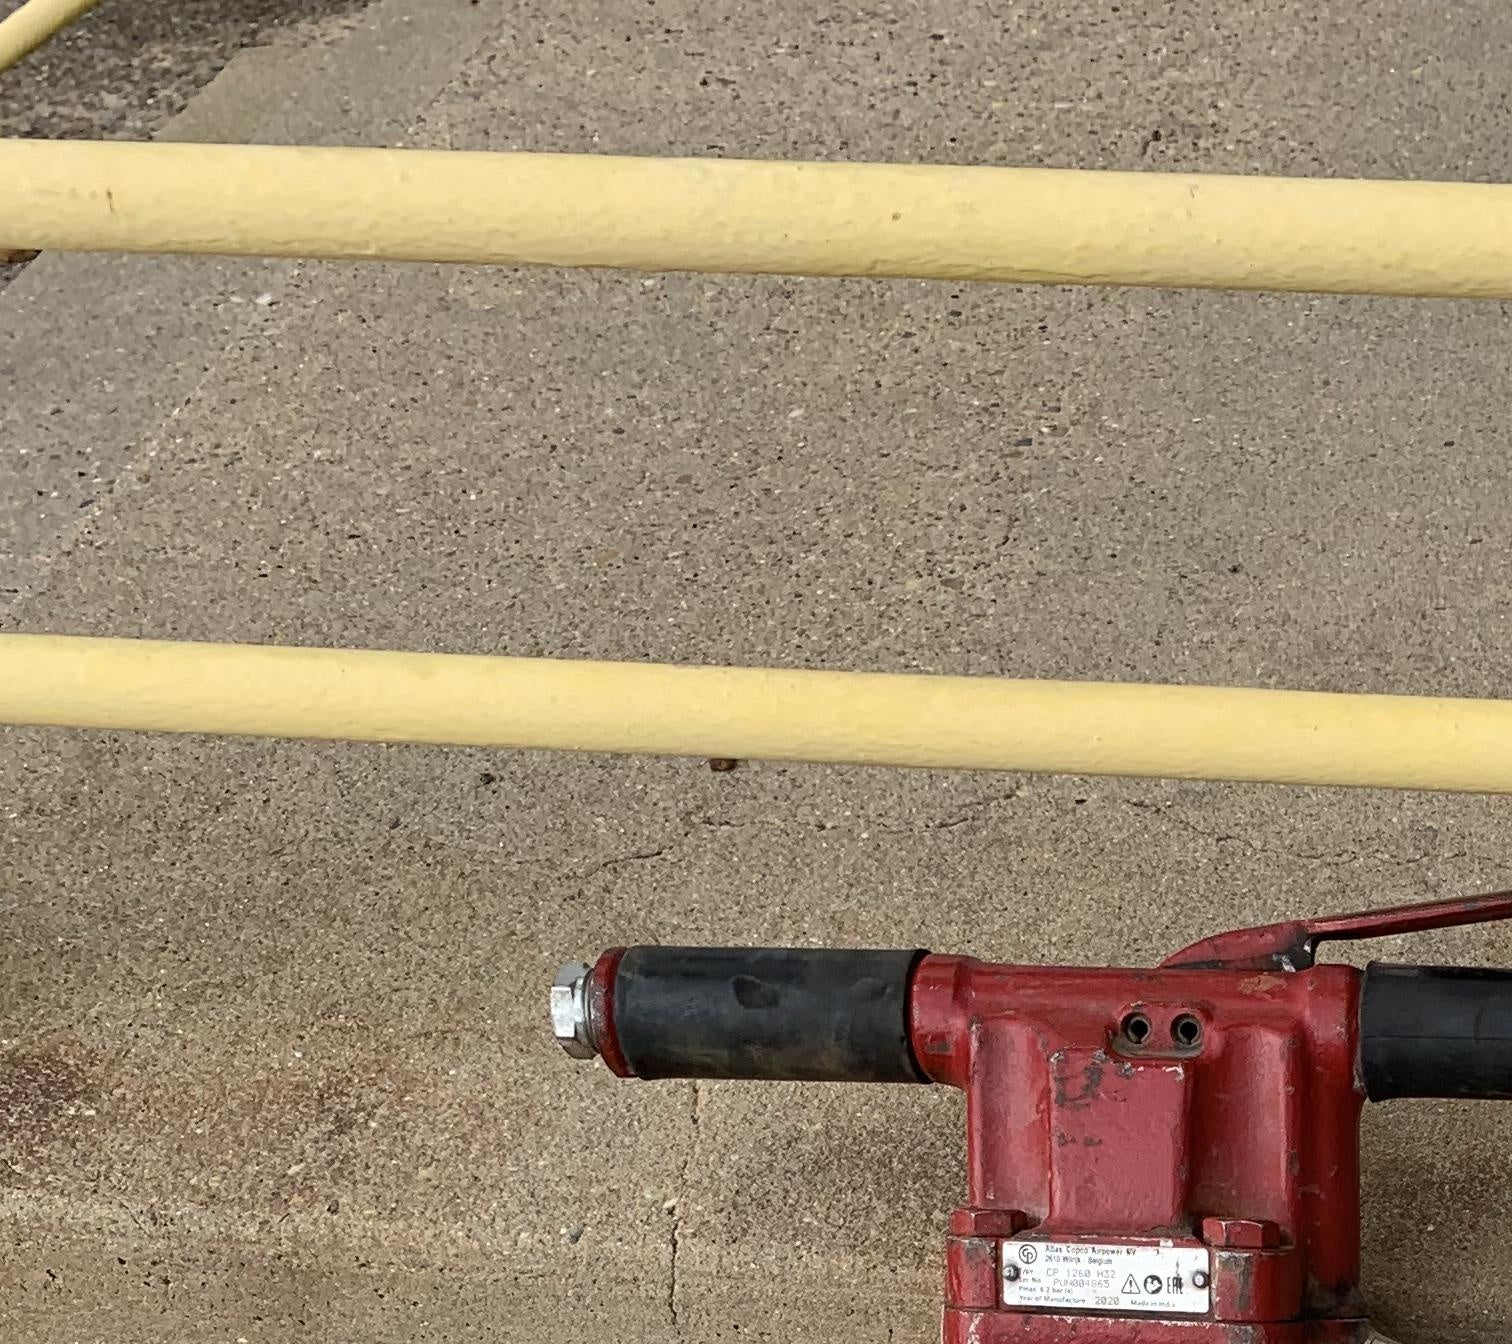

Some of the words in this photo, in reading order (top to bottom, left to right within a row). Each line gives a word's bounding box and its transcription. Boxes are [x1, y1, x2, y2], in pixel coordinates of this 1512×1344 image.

[1045, 1245, 1062, 1253] Atlas
[1066, 1245, 1088, 1254] Copco
[1066, 1268, 1090, 1277] 1260
[1094, 1296, 1119, 1305] 2020
